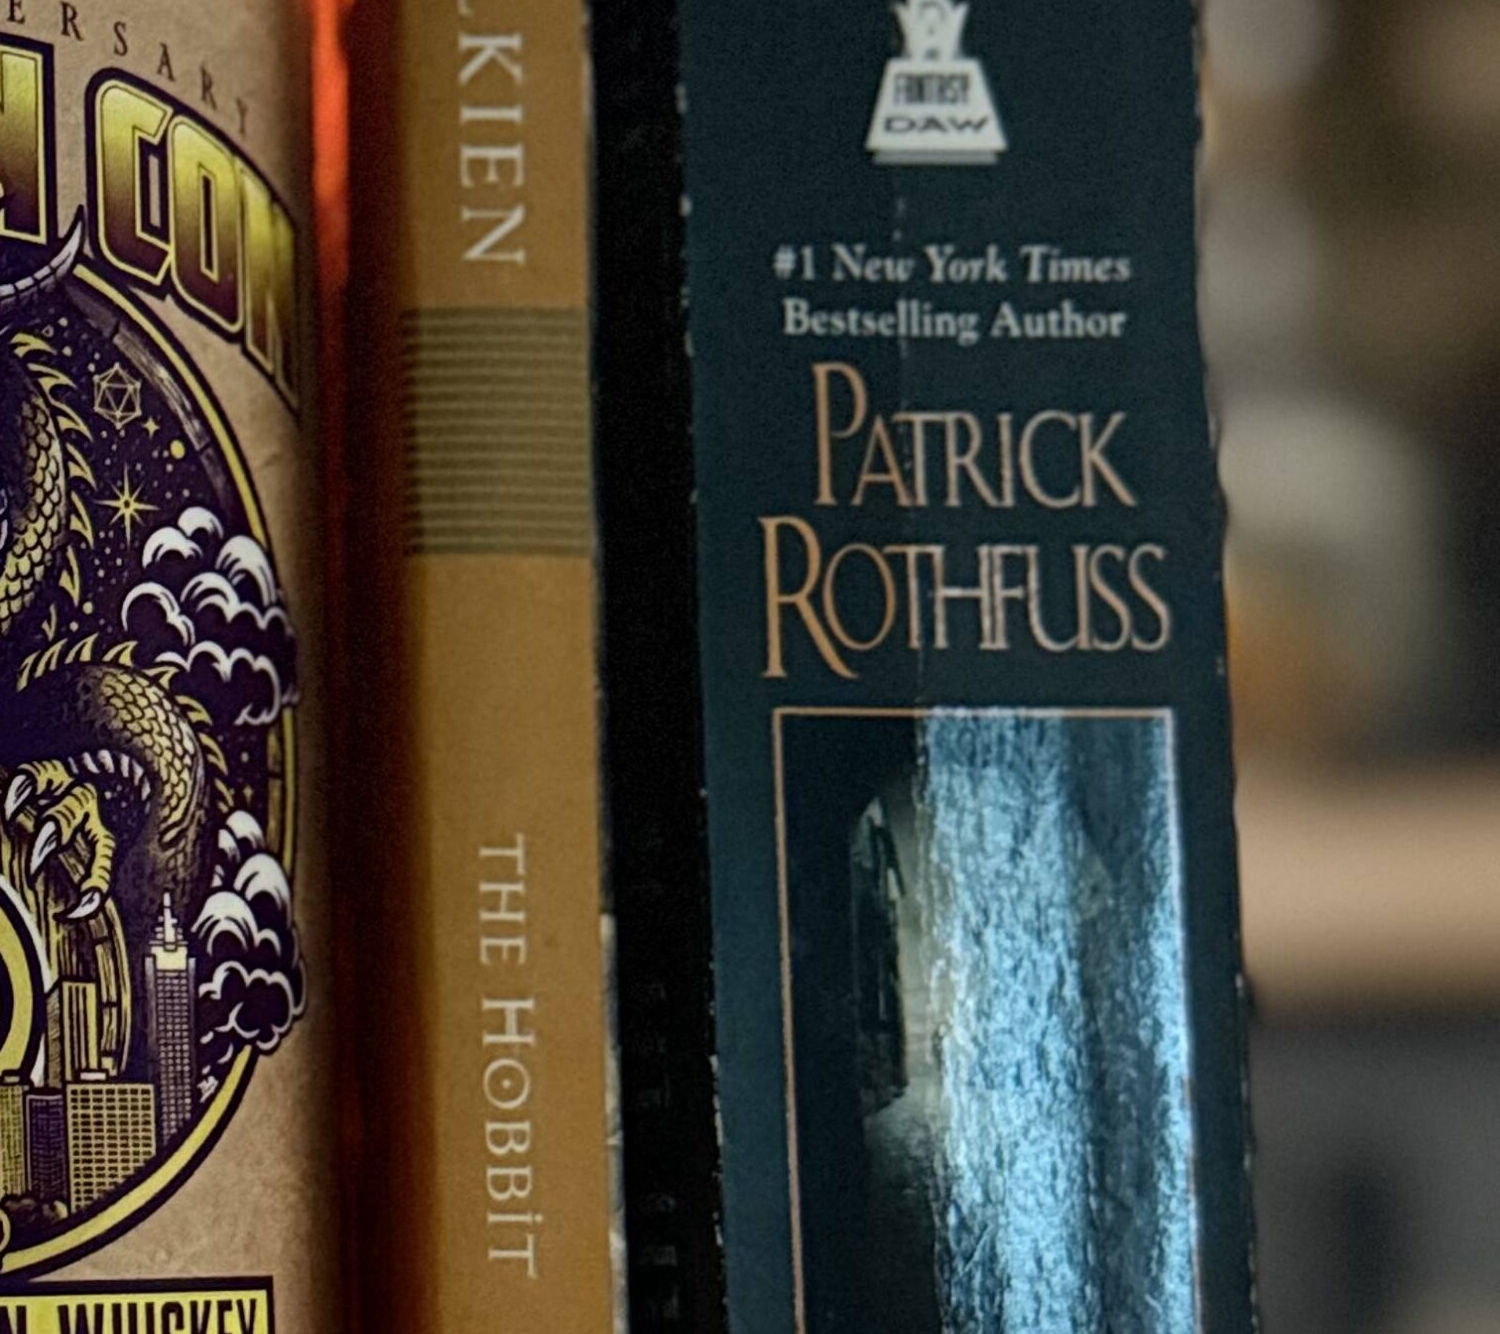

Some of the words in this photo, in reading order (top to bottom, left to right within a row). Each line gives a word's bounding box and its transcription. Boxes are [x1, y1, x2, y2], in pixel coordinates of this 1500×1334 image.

[884, 116, 990, 134] DAW
[773, 246, 816, 283] #1
[833, 245, 911, 283] New
[925, 245, 1008, 283] York
[1020, 245, 1131, 283] Times
[783, 298, 979, 345] Bestselling
[991, 300, 1126, 338] Author
[812, 362, 1136, 508] PATRICK
[760, 516, 1172, 679] ROTHFUSS
[479, 833, 526, 965] THE
